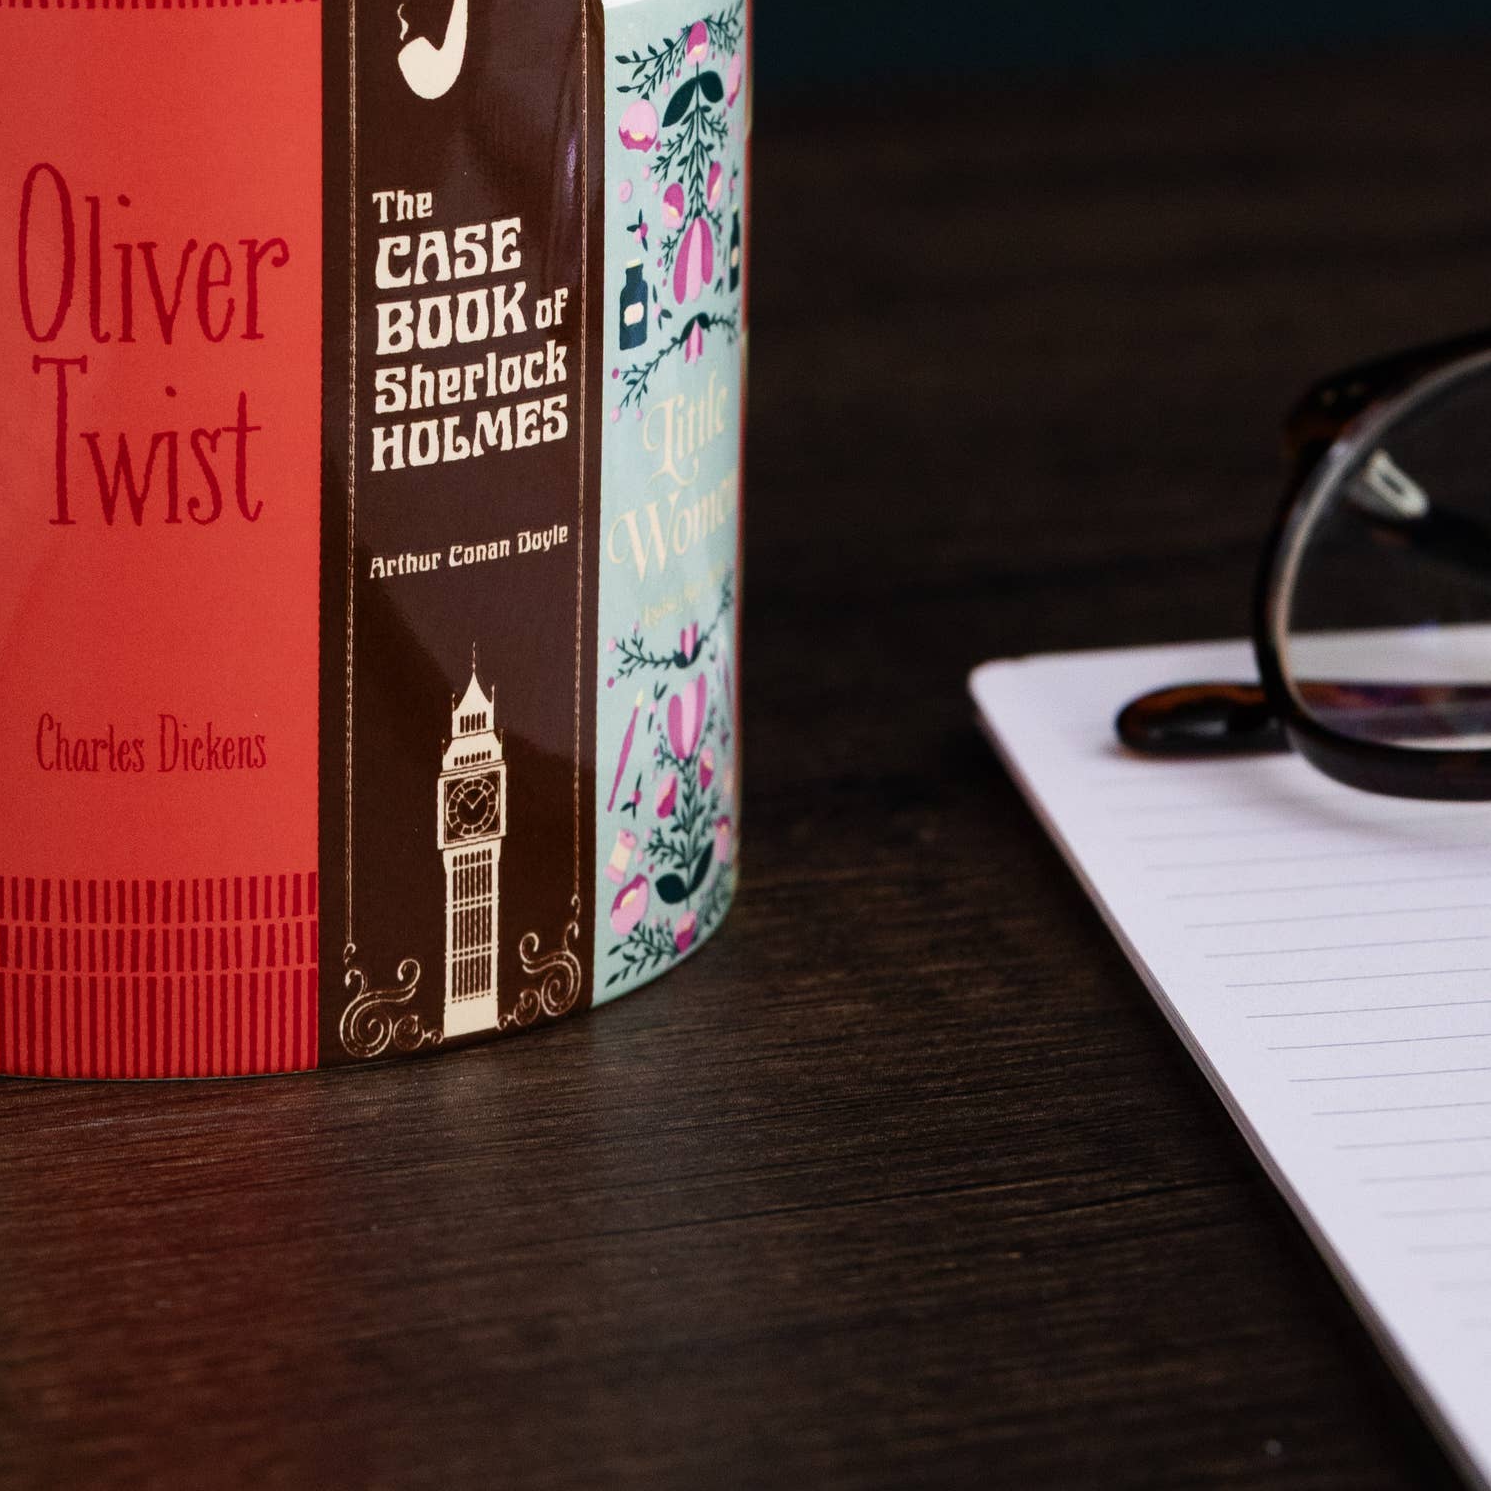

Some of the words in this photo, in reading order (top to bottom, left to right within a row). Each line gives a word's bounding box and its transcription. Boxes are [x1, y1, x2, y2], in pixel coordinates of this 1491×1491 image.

[372, 189, 433, 224] The
[18, 162, 290, 345] Oliver
[374, 216, 521, 290] CASE
[375, 280, 527, 356] BOOK
[535, 287, 569, 330] of
[374, 339, 568, 415] Sherlock
[32, 354, 264, 527] Twist
[369, 394, 569, 473] HOLMES
[642, 369, 729, 488] Little
[369, 551, 442, 580] Arthur
[448, 538, 510, 570] Conan
[517, 524, 569, 556] Doyle
[36, 712, 145, 772] Charles
[157, 713, 267, 773] Dickens
